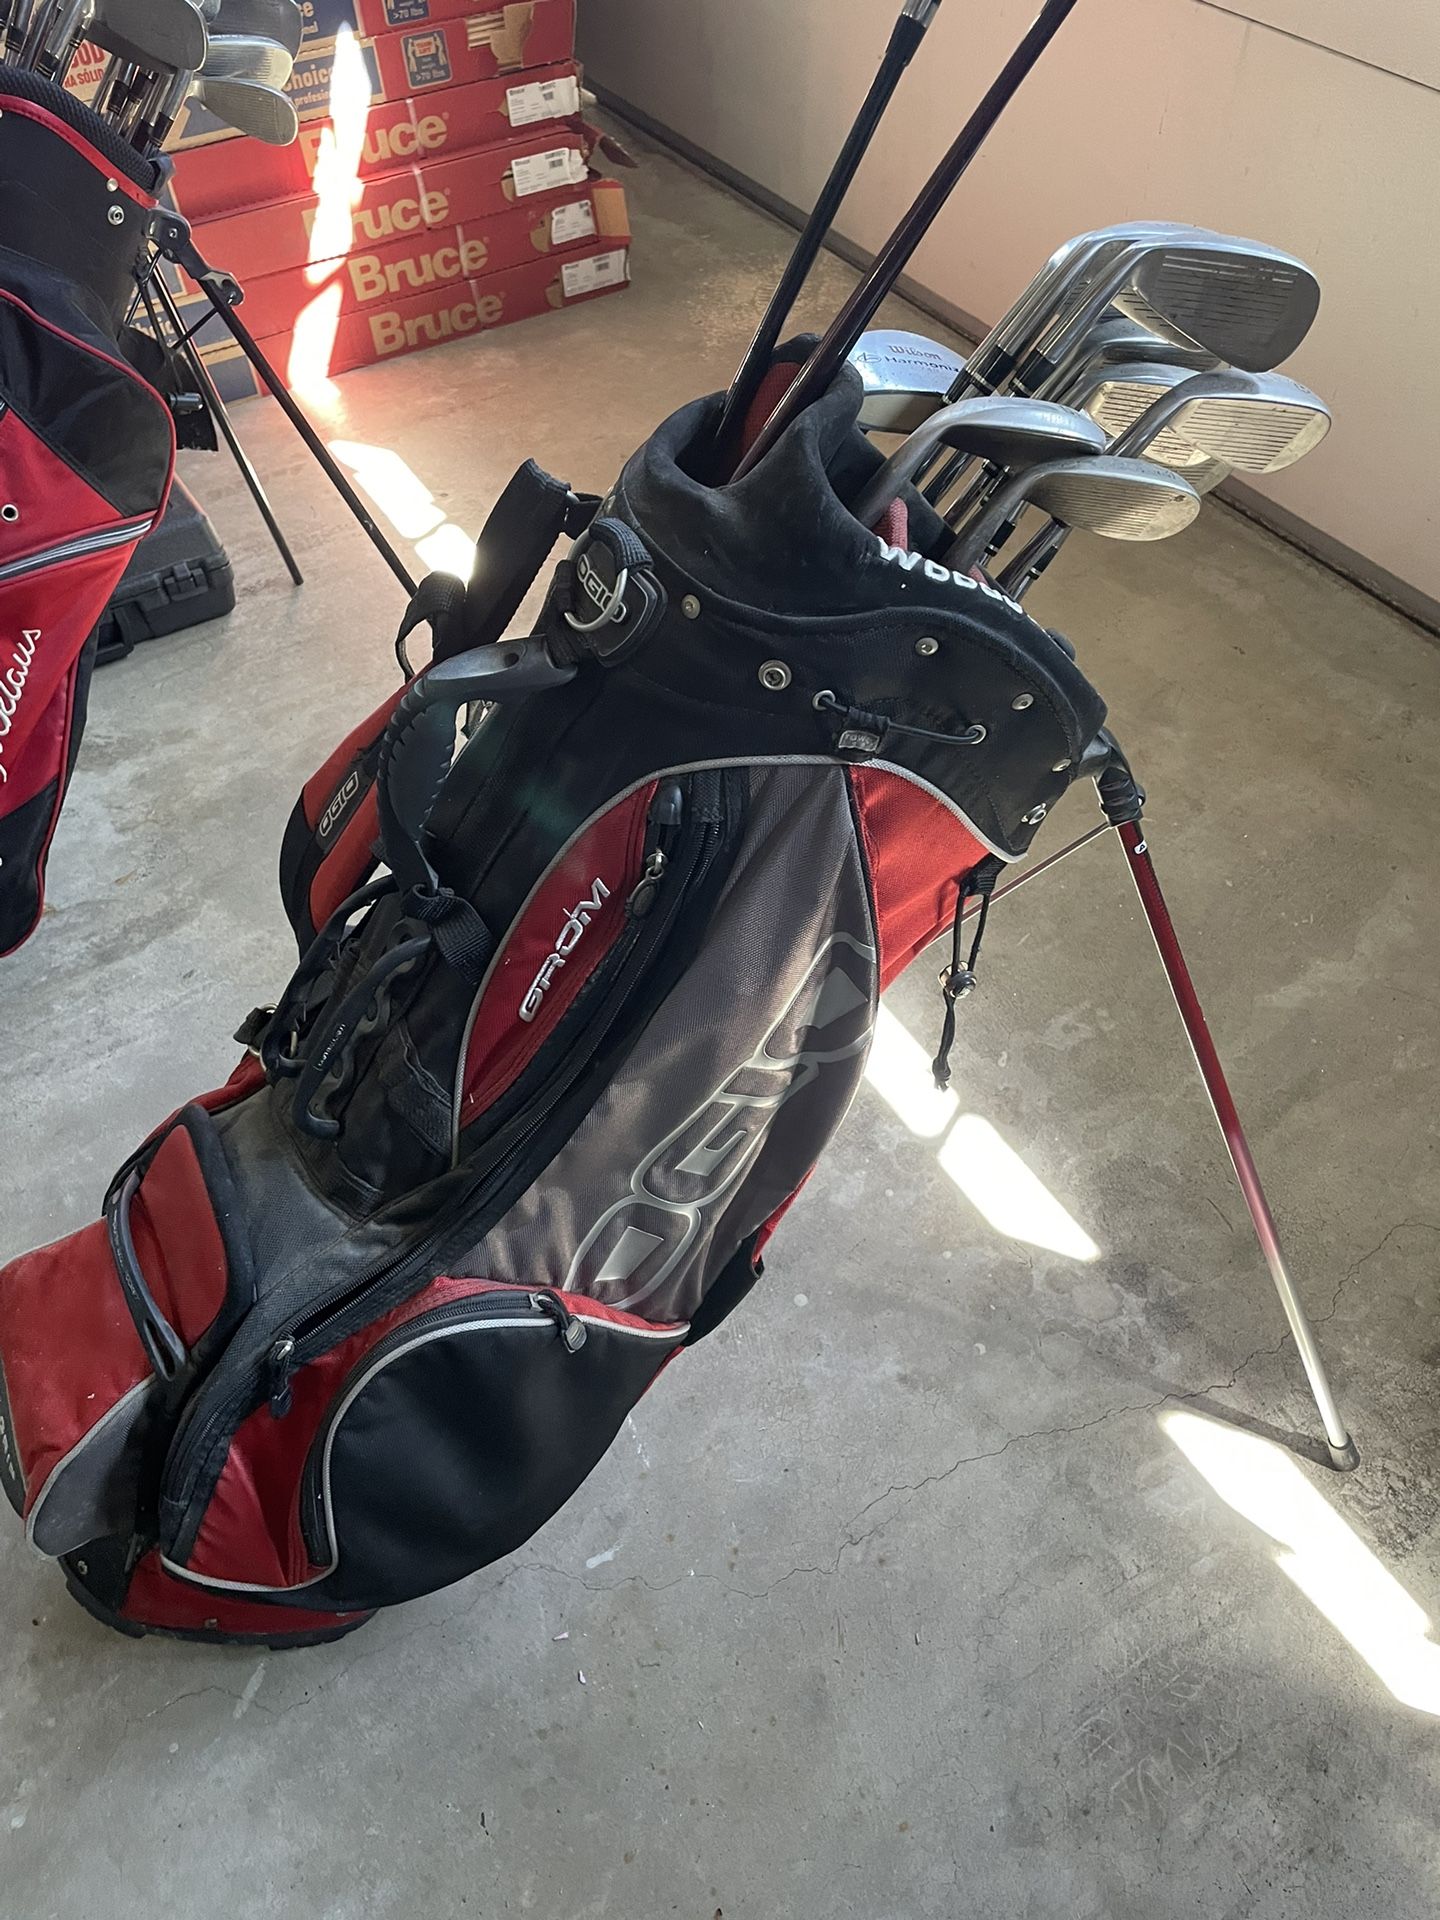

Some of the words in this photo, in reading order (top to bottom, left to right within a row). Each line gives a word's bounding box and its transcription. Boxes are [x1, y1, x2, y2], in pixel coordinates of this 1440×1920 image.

[347, 239, 488, 301] Bruce
[369, 294, 503, 355] Bruce
[888, 345, 941, 361] Wilson
[319, 771, 359, 837] OGIO
[563, 932, 877, 1311] OGIO
